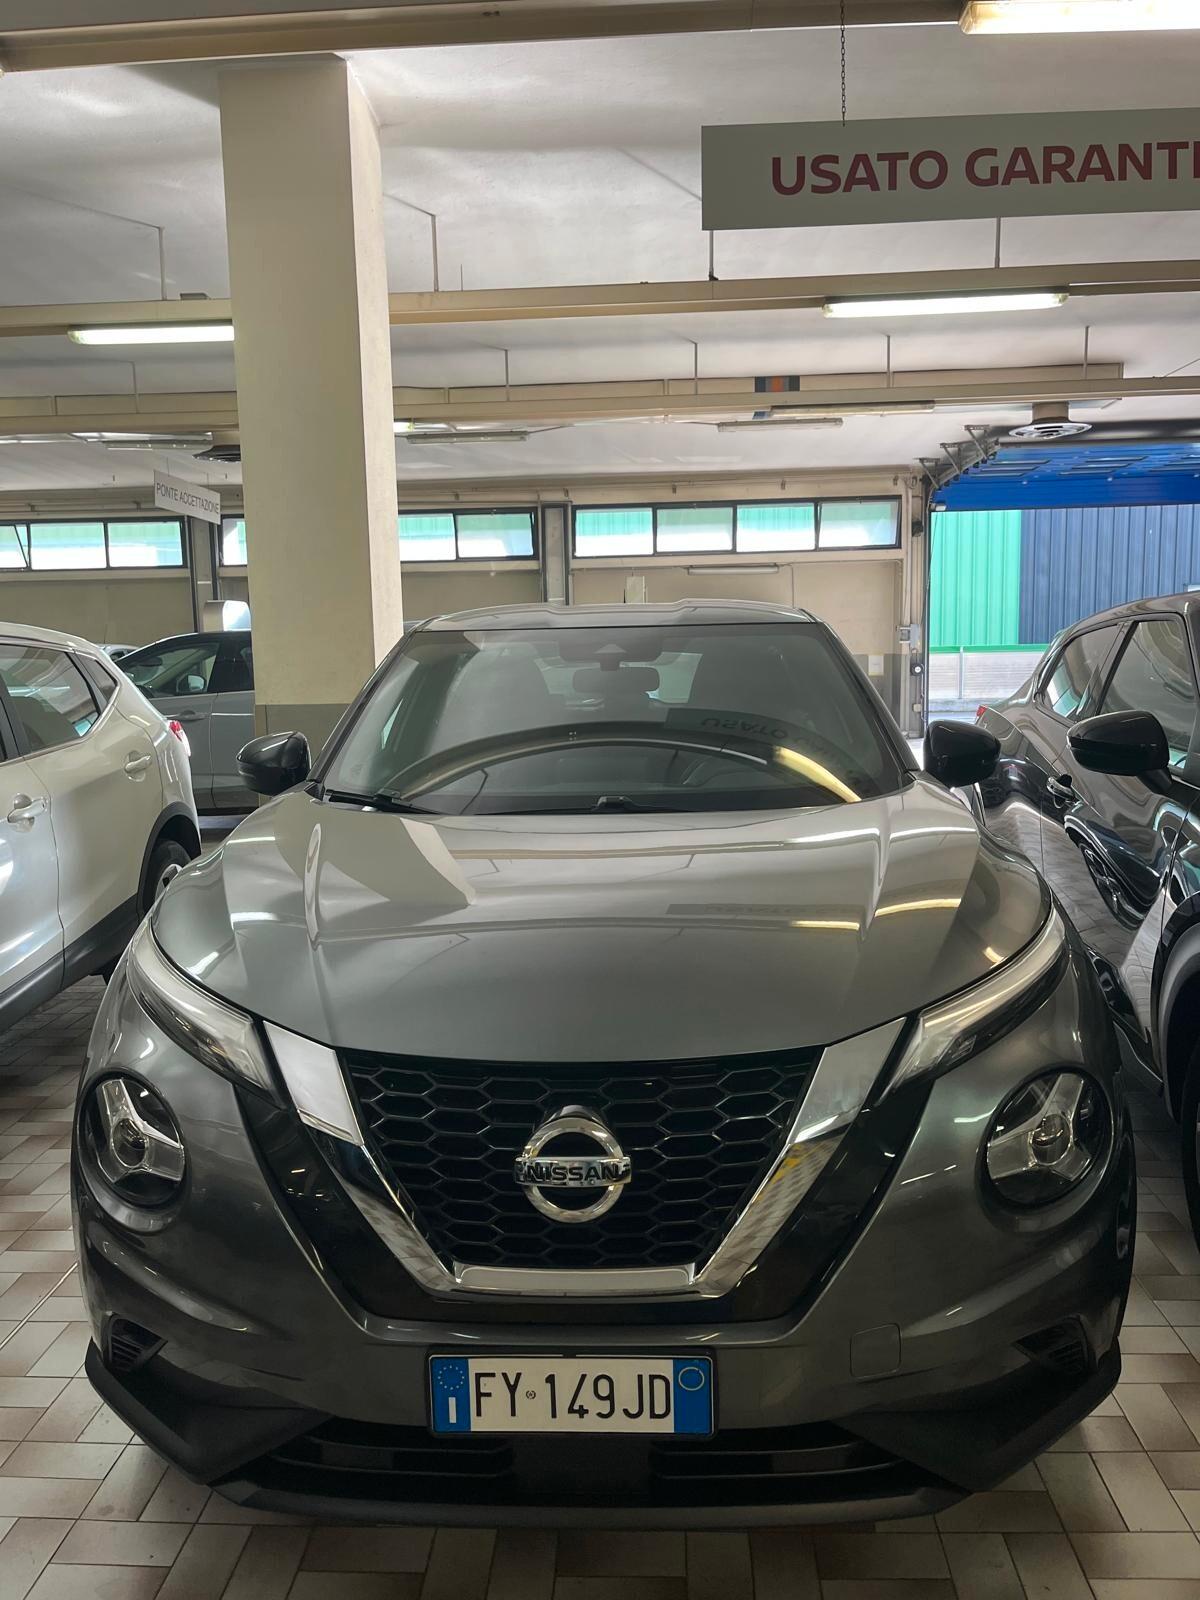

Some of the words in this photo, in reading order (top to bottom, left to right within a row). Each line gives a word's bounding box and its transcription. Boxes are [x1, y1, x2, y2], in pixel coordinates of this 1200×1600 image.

[771, 150, 949, 196] USATO
[156, 482, 178, 502] PONTE
[523, 1162, 620, 1182] NISSAN
[475, 1371, 522, 1417] FY
